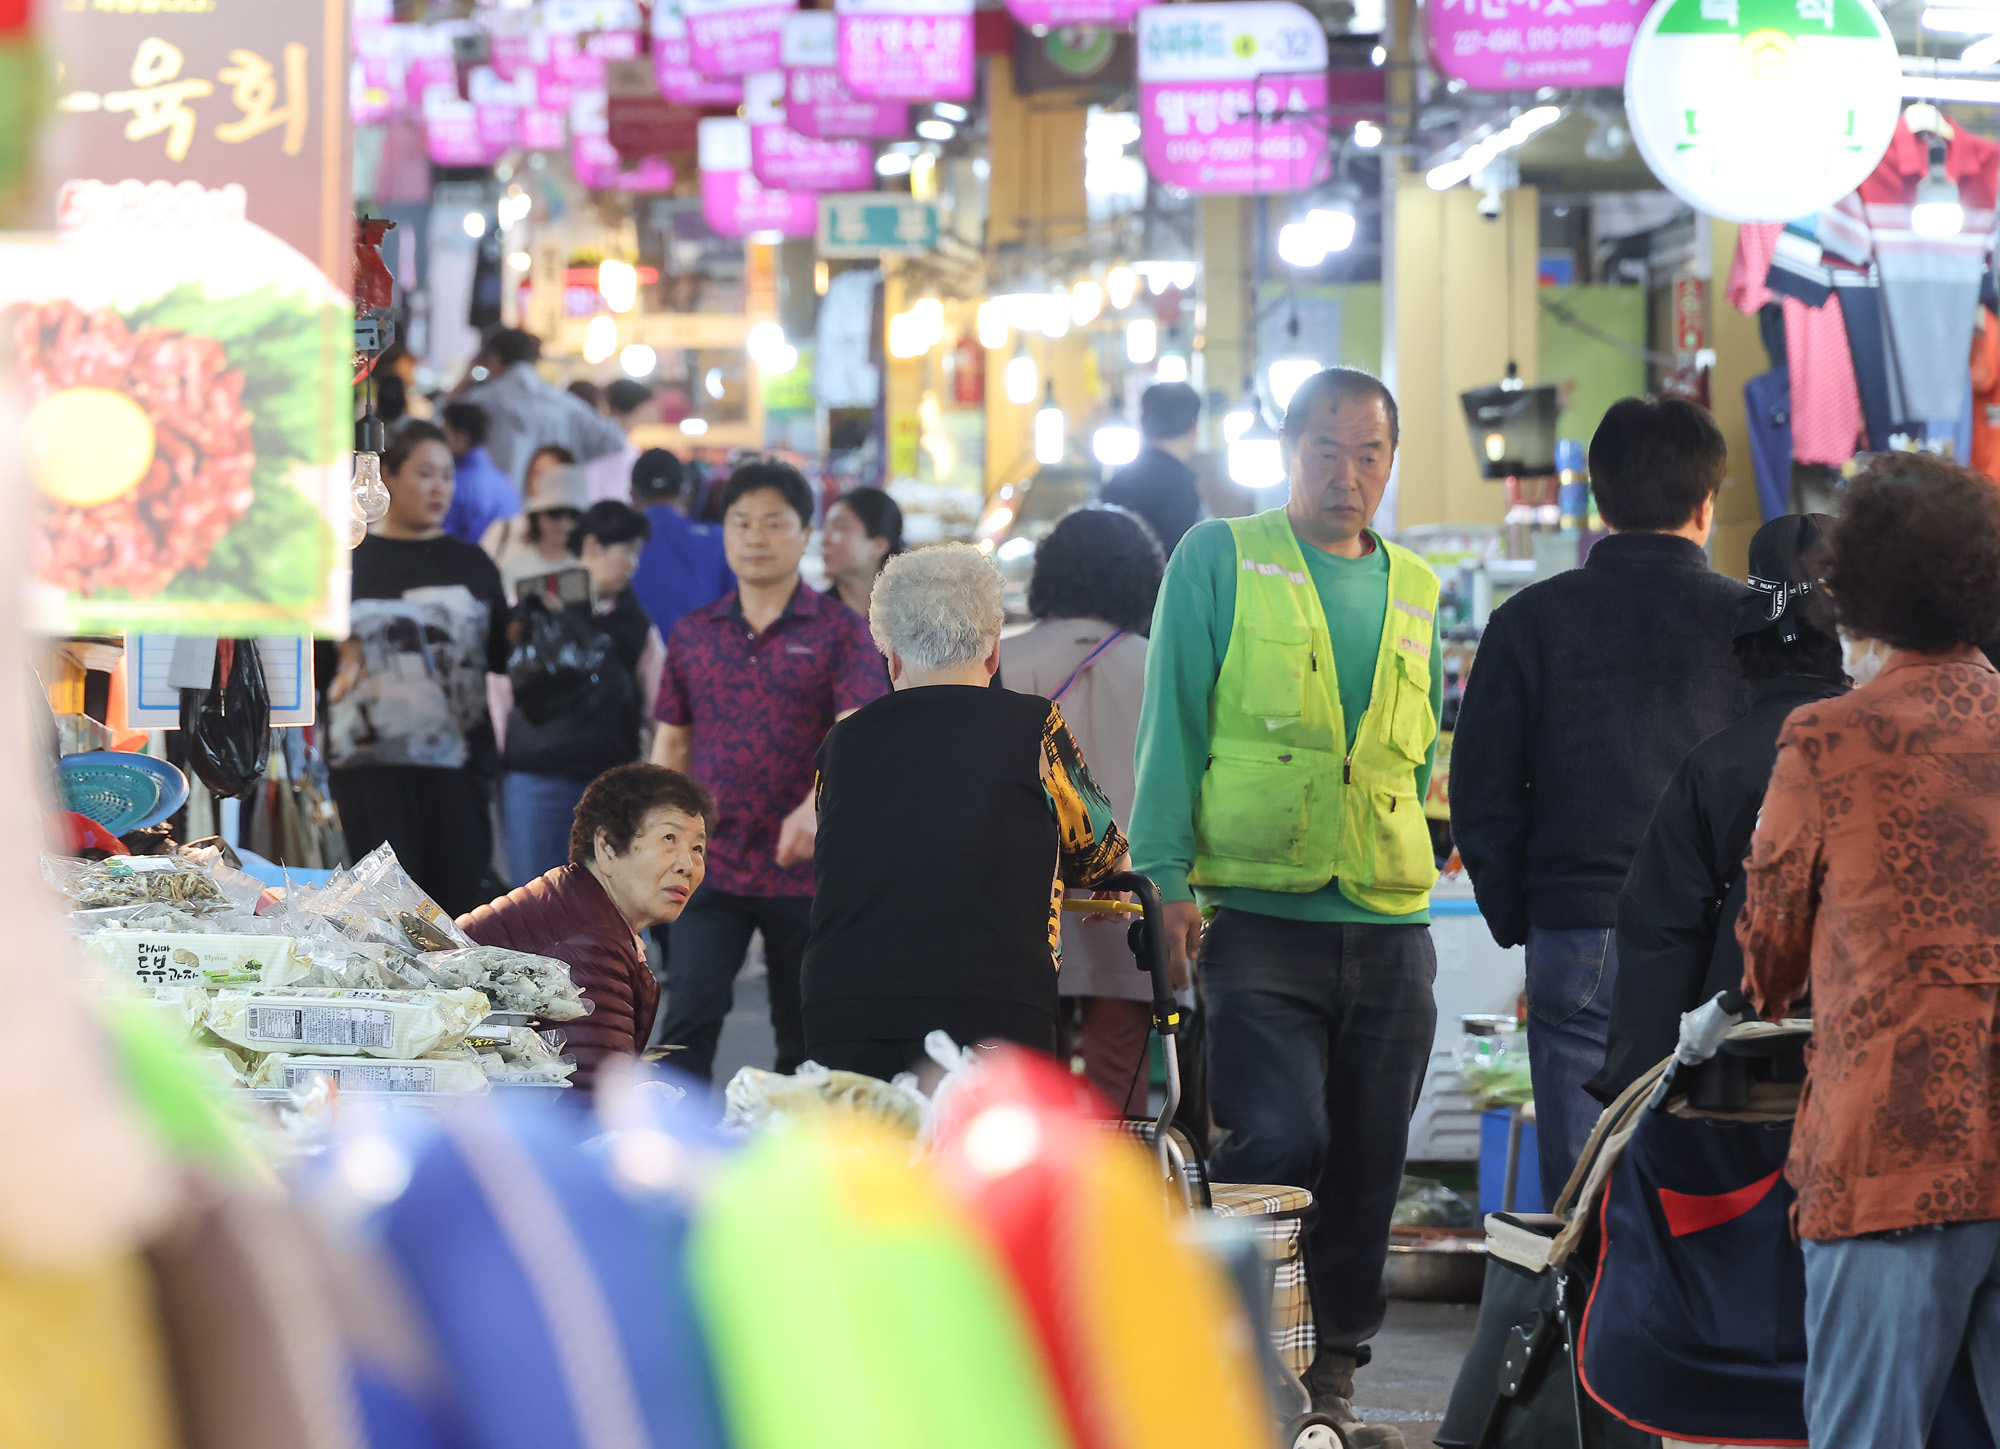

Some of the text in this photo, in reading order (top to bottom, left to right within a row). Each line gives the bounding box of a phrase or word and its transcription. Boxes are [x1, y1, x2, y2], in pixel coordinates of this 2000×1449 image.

[138, 943, 171, 953] 다시마
[204, 954, 228, 962] Elysion
[136, 954, 199, 983] 두부 과자
